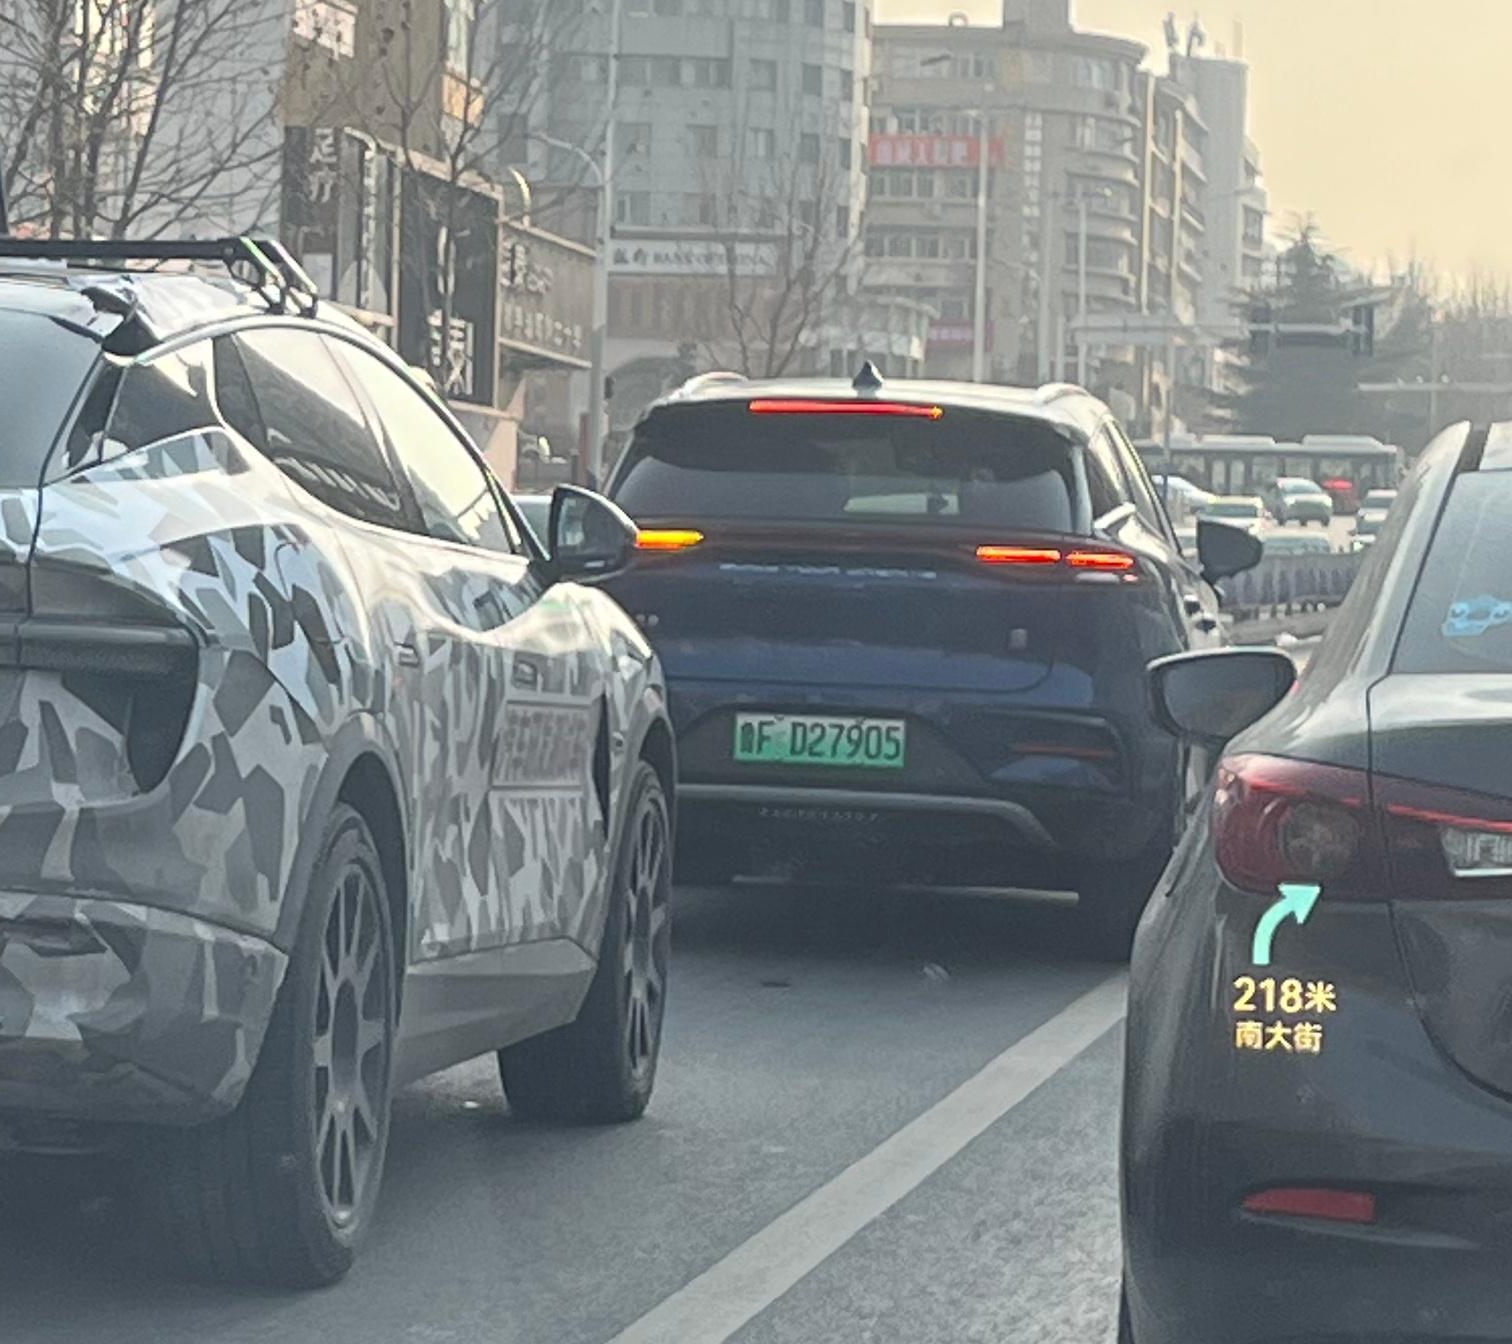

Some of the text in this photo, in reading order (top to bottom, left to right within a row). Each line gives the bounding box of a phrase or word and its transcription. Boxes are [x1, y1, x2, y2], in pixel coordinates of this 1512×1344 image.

[790, 721, 901, 760] D27905
[1233, 975, 1337, 1014] 218米
[1235, 1019, 1323, 1055] 南大街
